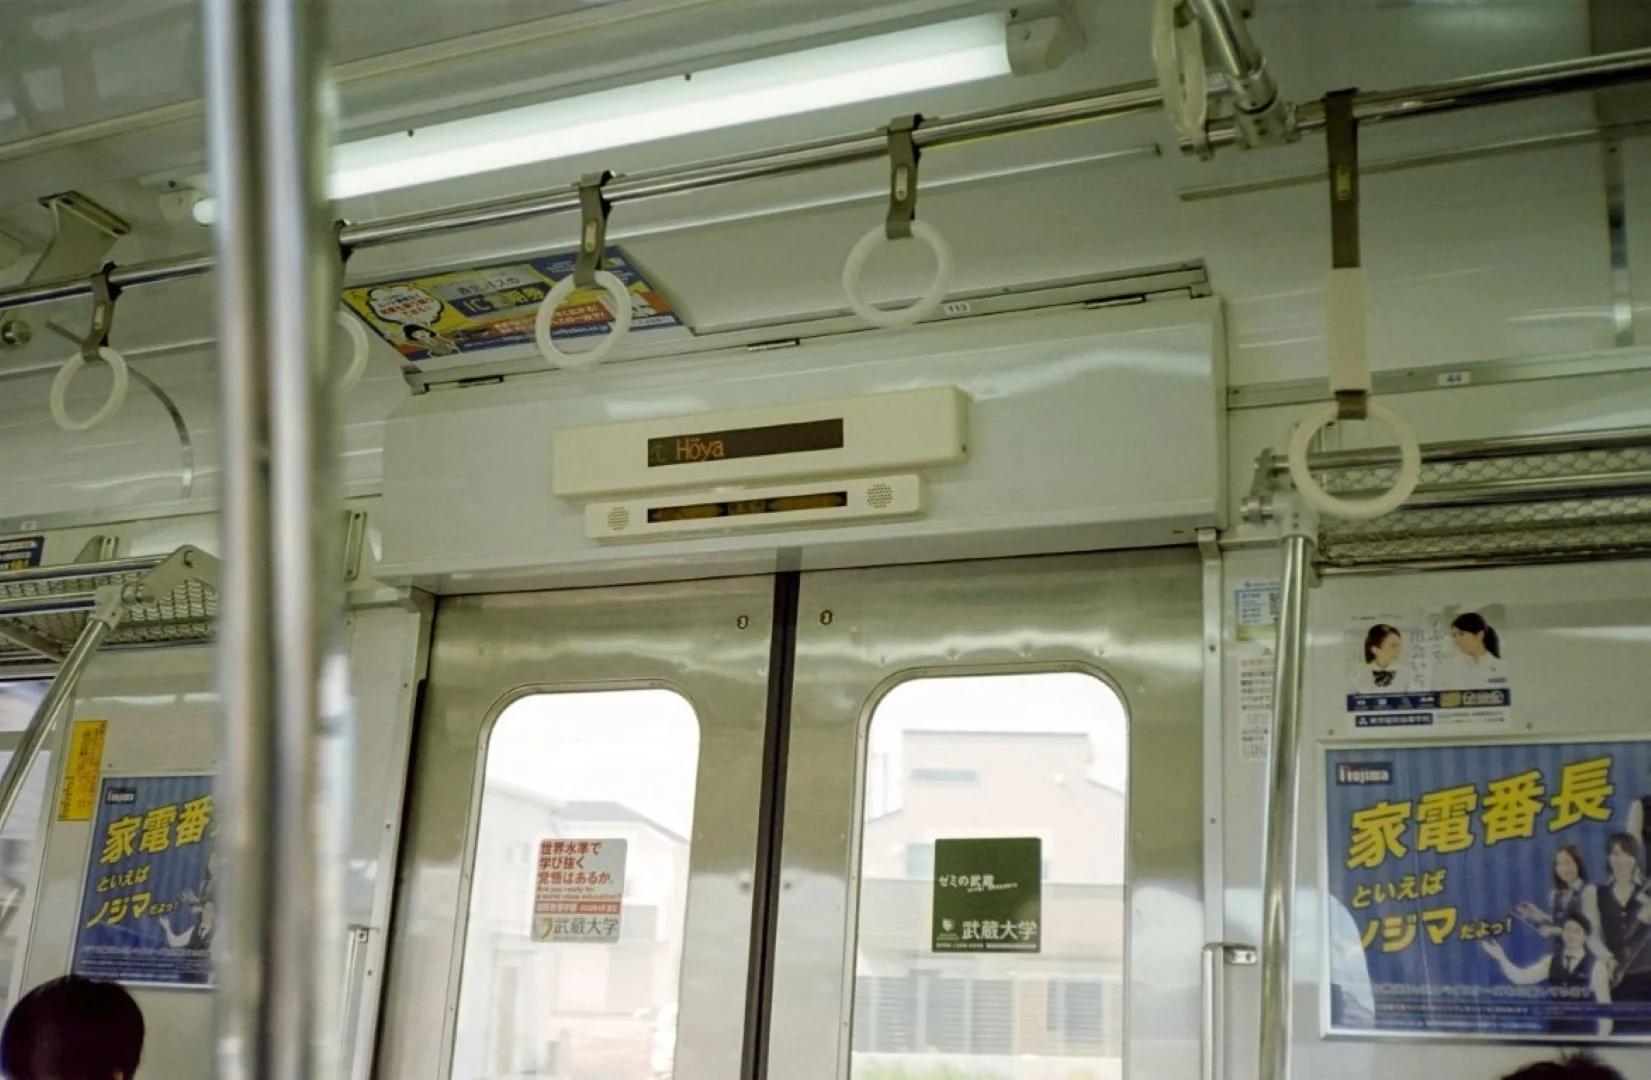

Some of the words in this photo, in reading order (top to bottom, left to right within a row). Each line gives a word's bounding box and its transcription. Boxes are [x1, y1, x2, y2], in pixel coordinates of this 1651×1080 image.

[675, 437, 726, 464] Hōya
[1346, 756, 1614, 869] 家電番長
[101, 794, 220, 864] 家電番
[541, 841, 602, 856] 世界水準で
[539, 856, 585, 870] 学び抜く
[96, 864, 152, 892] といえば
[1352, 869, 1447, 909] といえば
[553, 917, 619, 936] 武蔵大学
[961, 918, 1038, 941] 武蔵大学
